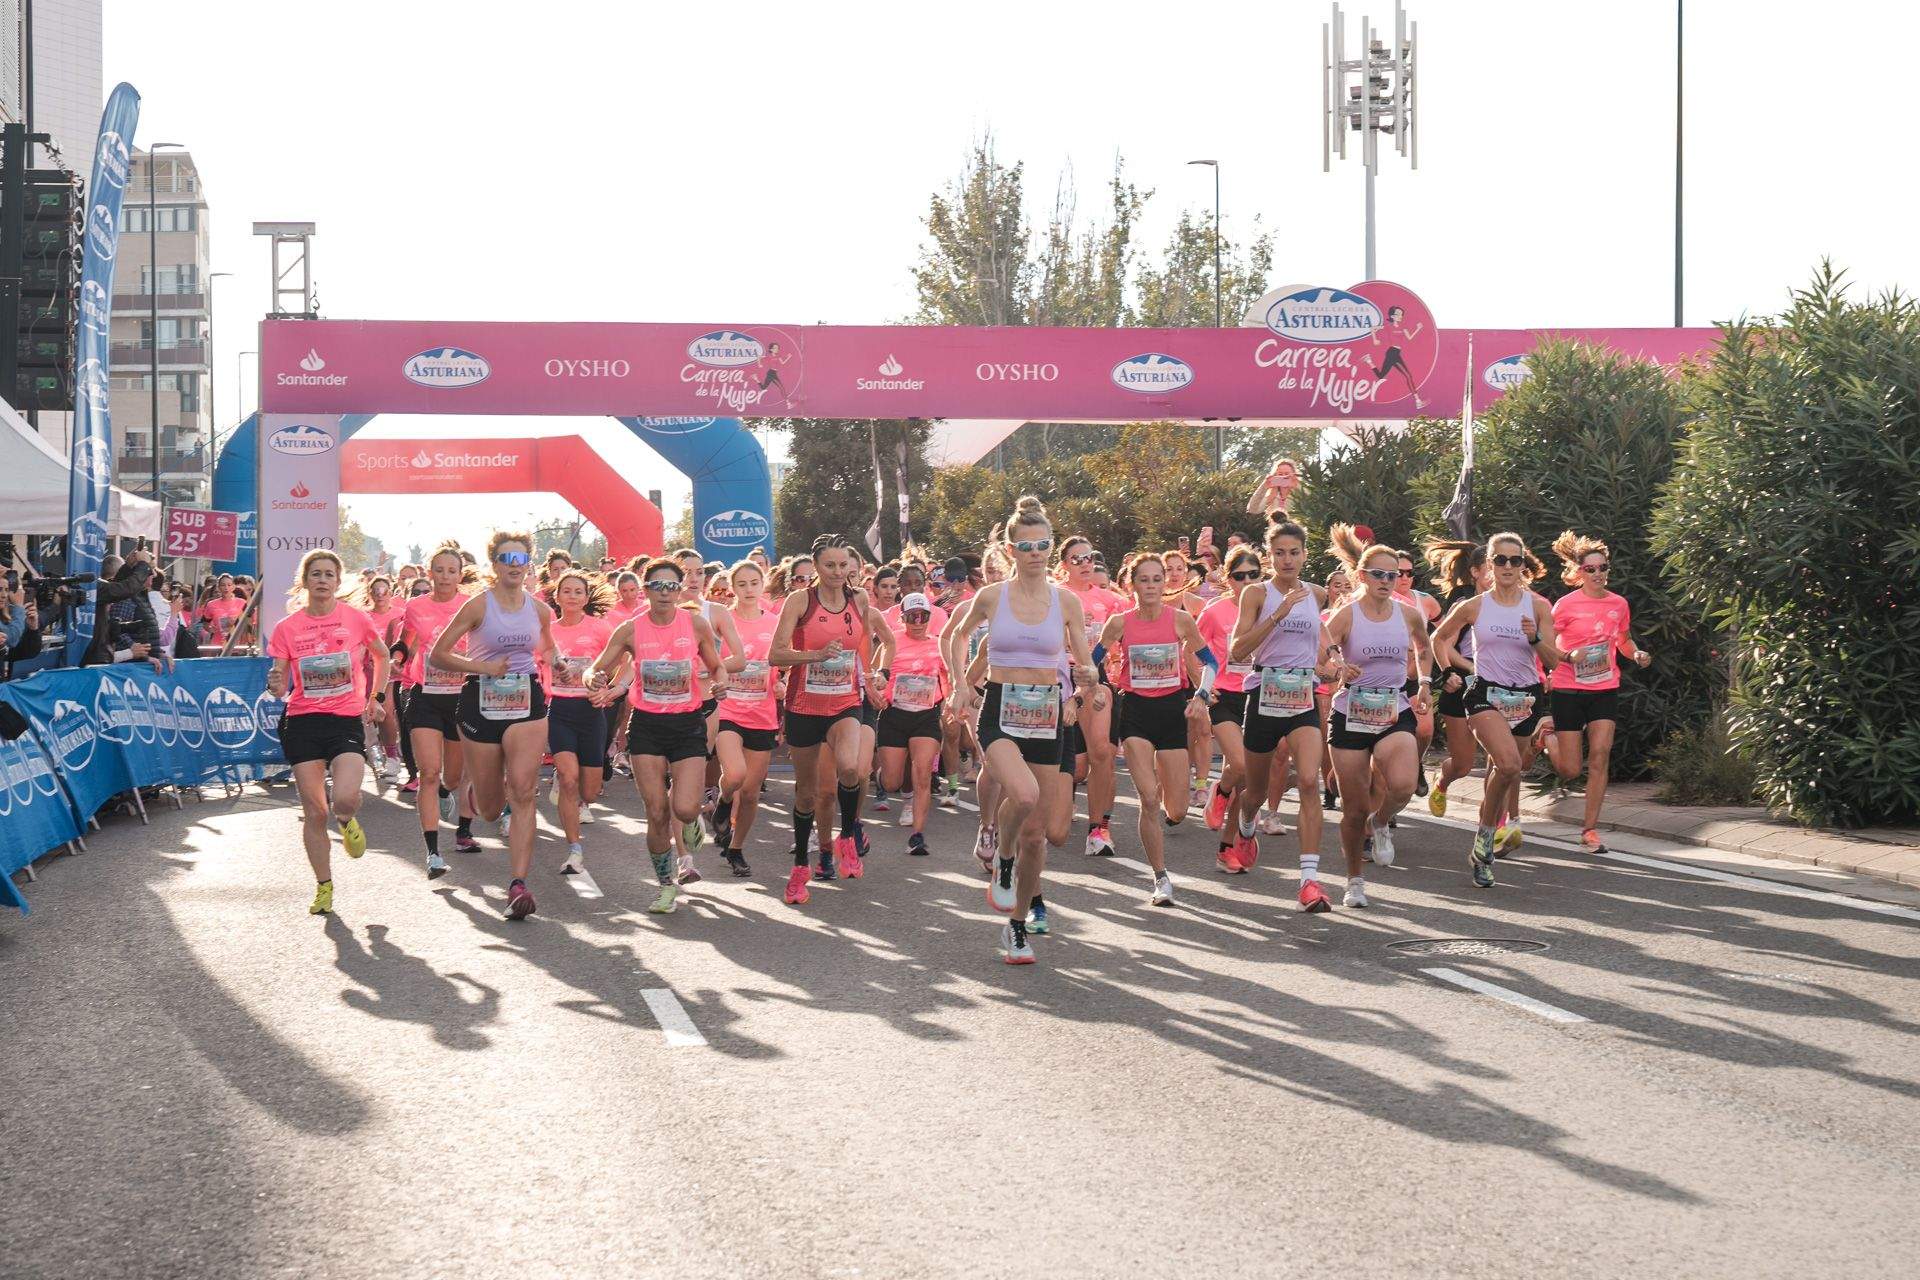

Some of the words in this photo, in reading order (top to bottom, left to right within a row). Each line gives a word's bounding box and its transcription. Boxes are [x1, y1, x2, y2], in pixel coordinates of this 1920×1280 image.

[1274, 307, 1373, 329] ASTURIANA
[694, 344, 759, 358] ASTURIANA
[1254, 338, 1353, 369] Carrera
[410, 361, 484, 378] ASTURIANA
[544, 358, 630, 378] OYSHO
[680, 363, 745, 384] Carrera
[976, 363, 1060, 382] OYSHO
[1117, 365, 1188, 383] ASTURIANA
[276, 373, 348, 386] Santander
[856, 377, 925, 391] Santander
[695, 384, 708, 397] de
[709, 384, 719, 397] la
[717, 380, 768, 412] Mujer
[1278, 369, 1297, 390] de
[1300, 367, 1314, 390] la
[1310, 365, 1388, 414] Mujer
[273, 436, 330, 449] ASTURIANA
[356, 452, 409, 473] Sports
[434, 451, 518, 469] Santander
[271, 500, 328, 510] Santander
[171, 511, 206, 528] SUB
[706, 523, 766, 538] ASTURIANA
[266, 536, 335, 551] OYSHO
[1278, 619, 1312, 630] OYSHO
[497, 634, 532, 644] OYSHO
[1362, 646, 1400, 656] OYSHO
